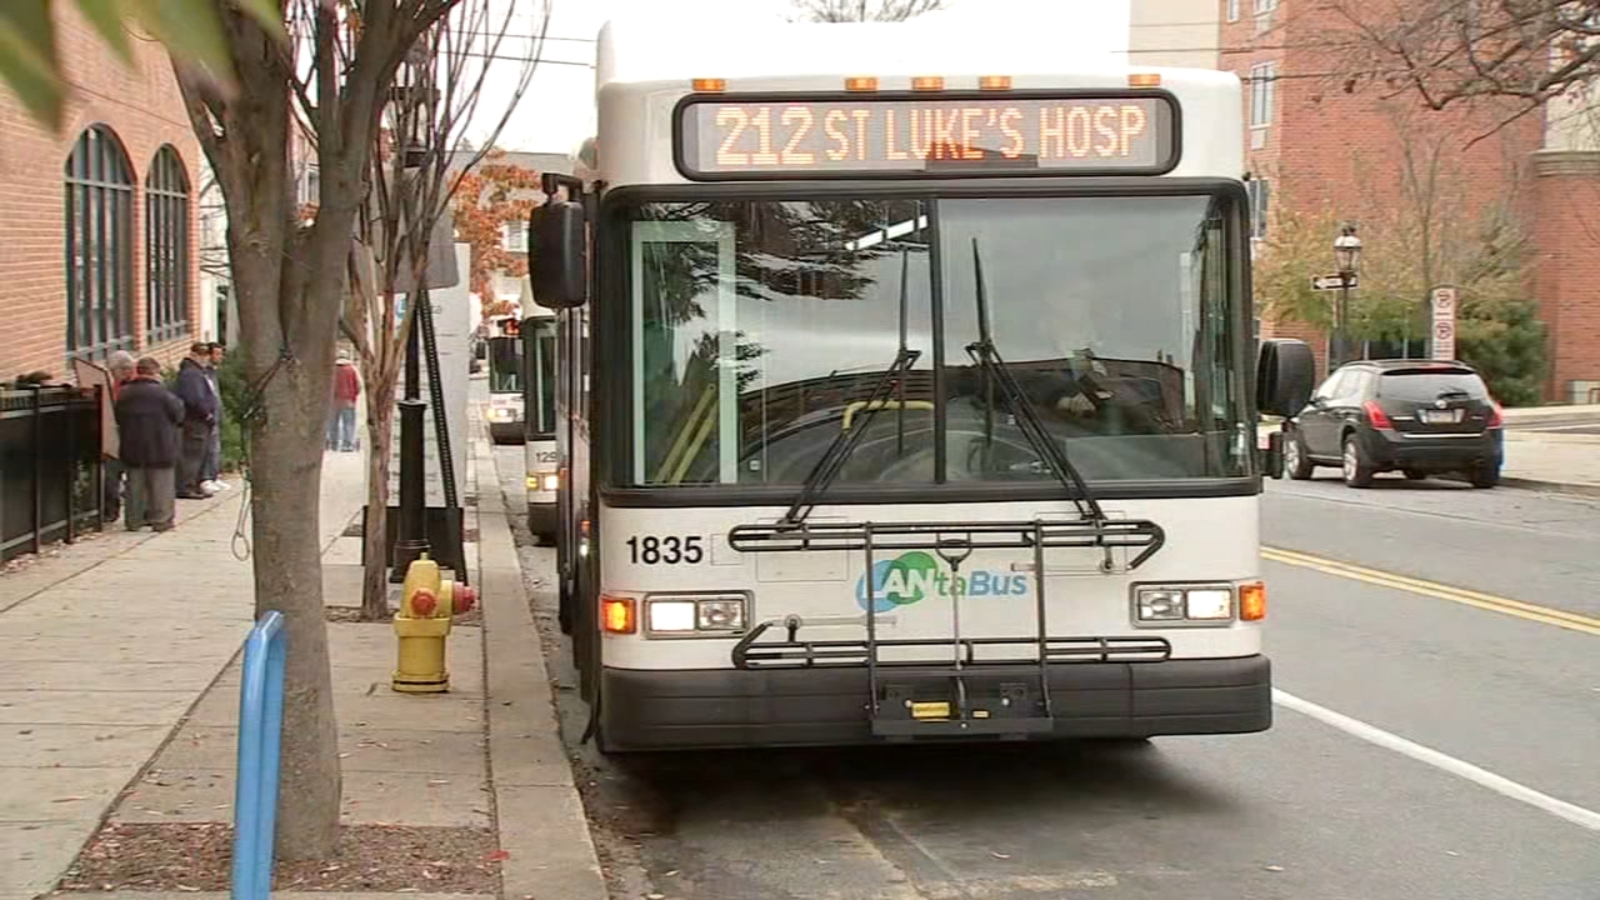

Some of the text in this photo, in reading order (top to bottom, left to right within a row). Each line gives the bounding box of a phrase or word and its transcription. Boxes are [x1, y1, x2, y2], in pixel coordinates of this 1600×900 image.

[715, 105, 1147, 165] 212 ST LUKE'S HOSP
[626, 536, 703, 564] 1835
